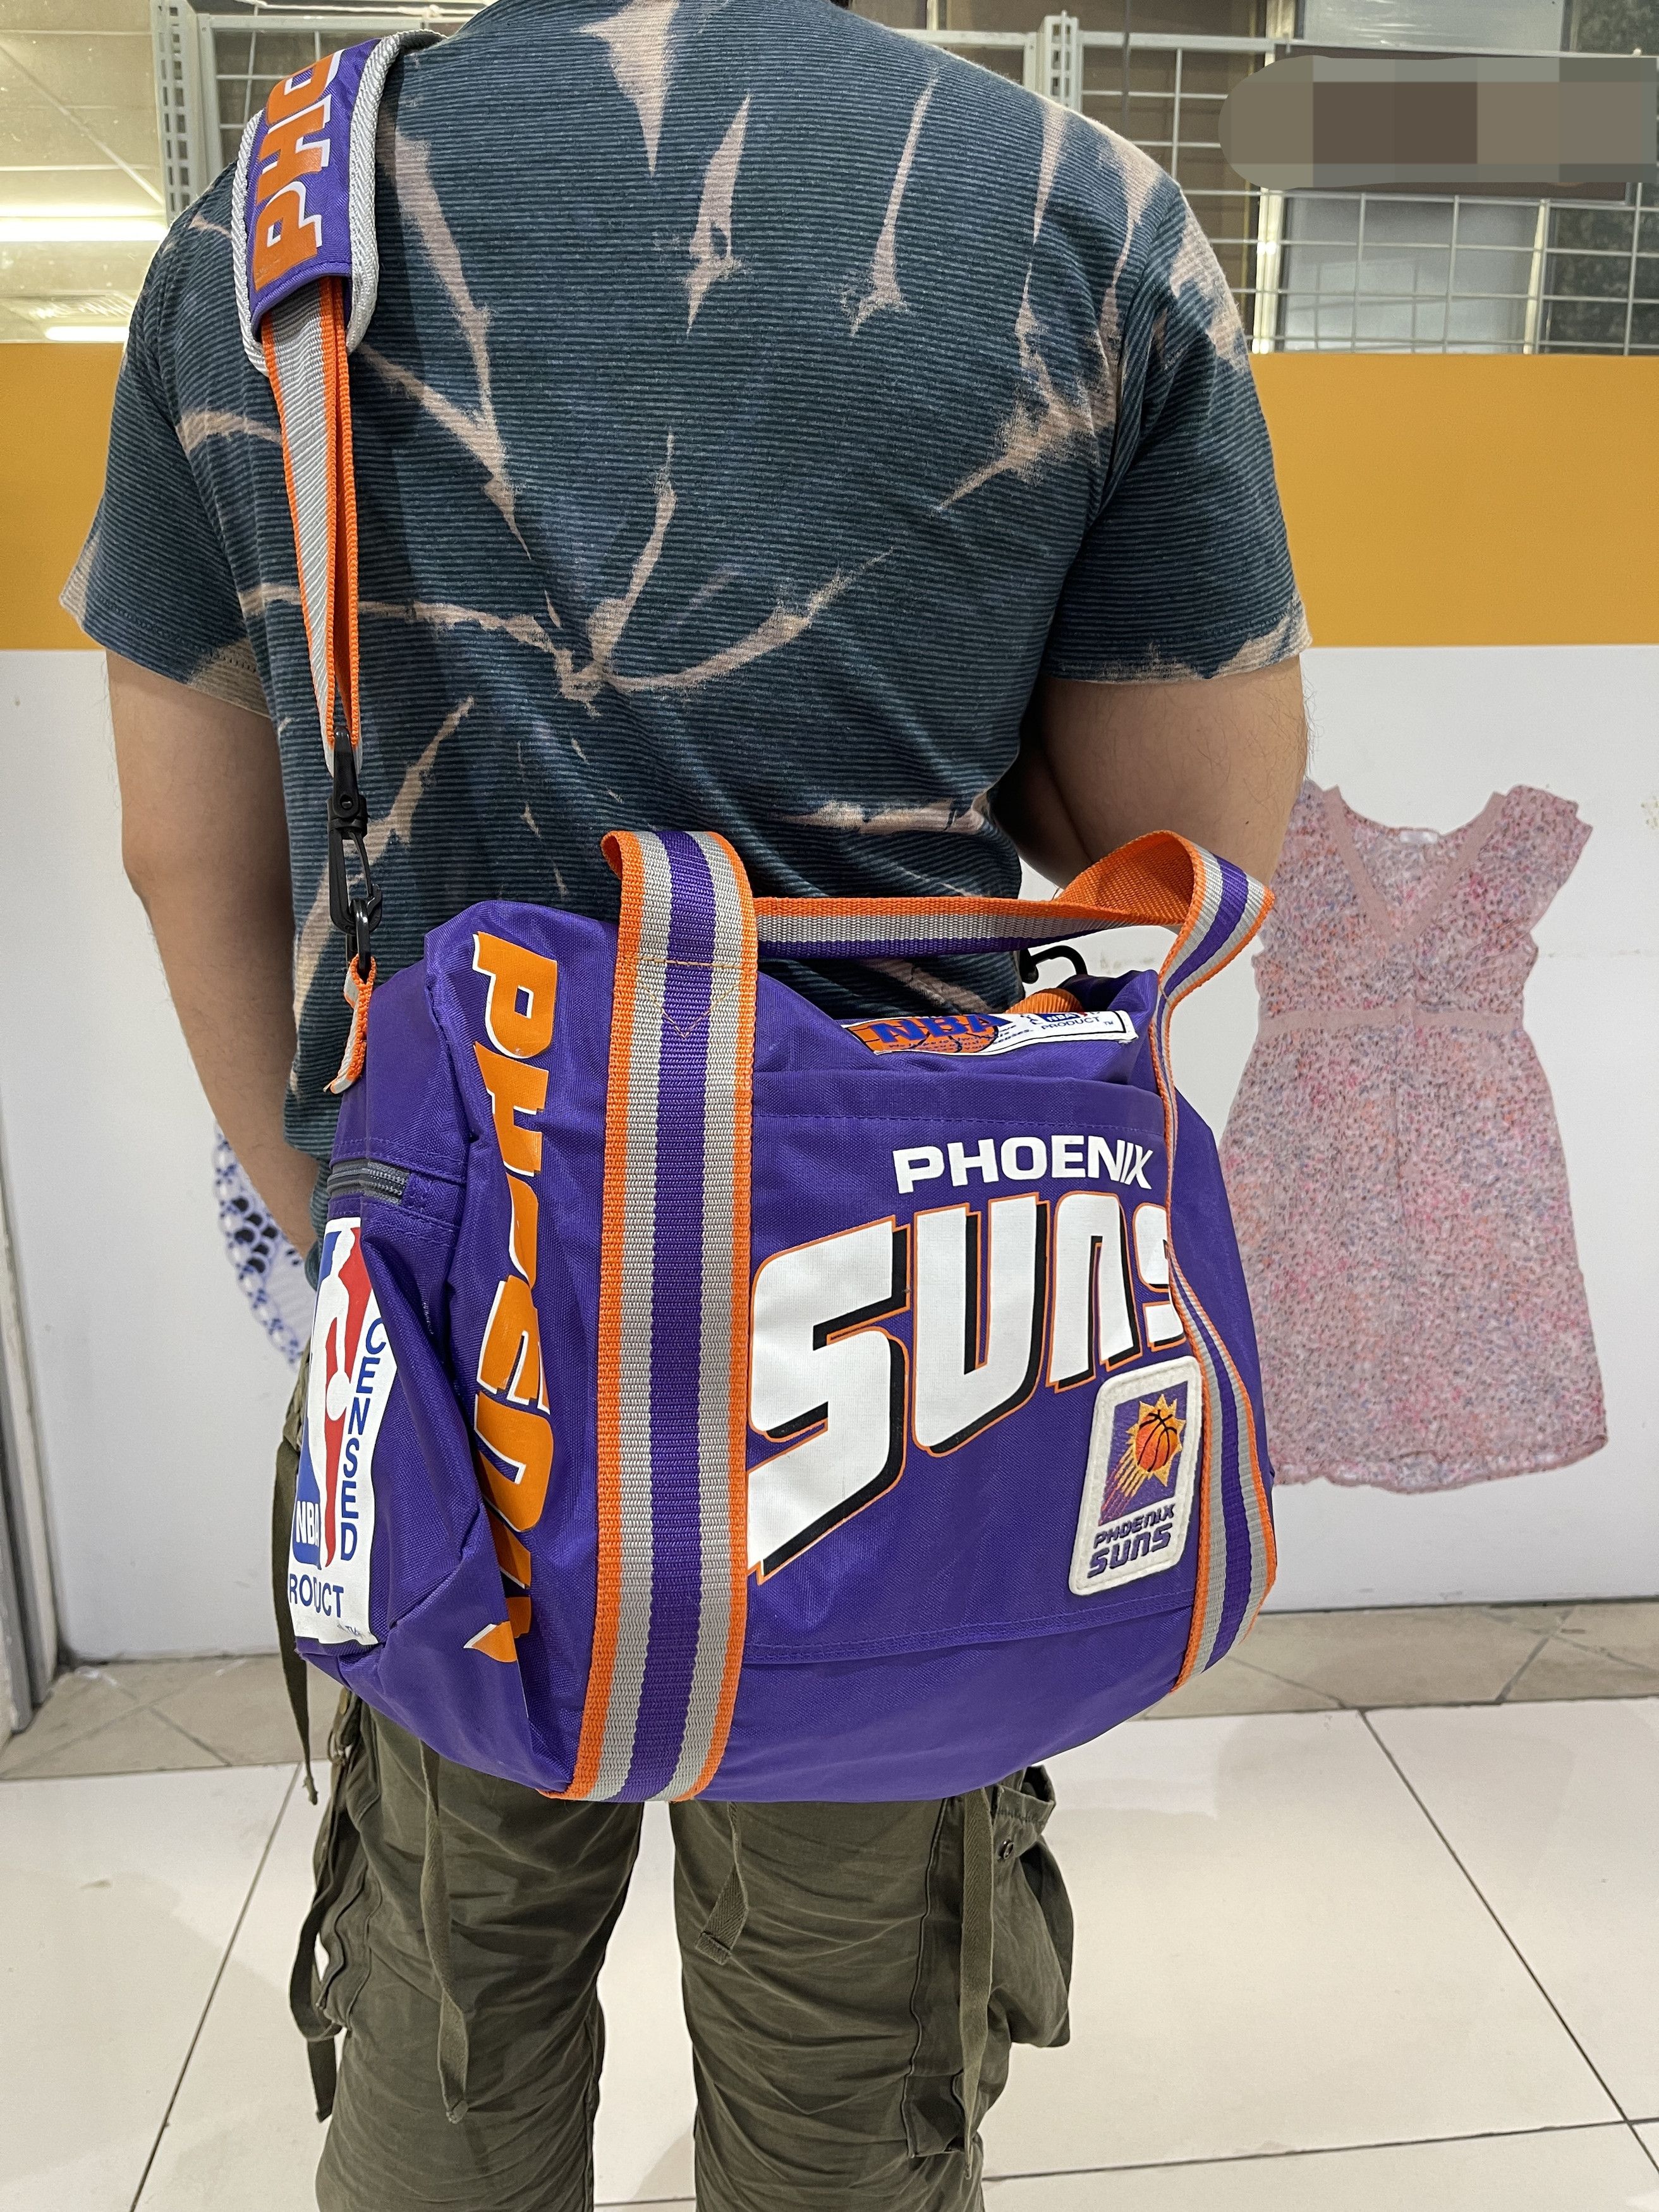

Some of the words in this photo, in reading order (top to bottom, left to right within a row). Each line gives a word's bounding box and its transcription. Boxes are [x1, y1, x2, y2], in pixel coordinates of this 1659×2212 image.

[873, 1014, 1013, 1044] NBA
[1041, 1016, 1100, 1030] PRODUCT
[892, 1134, 1155, 1194] PHOENIX
[746, 1191, 1189, 1586] SUNS
[1087, 1523, 1174, 1579] SUNS
[1093, 1502, 1176, 1549] PHOENIX
